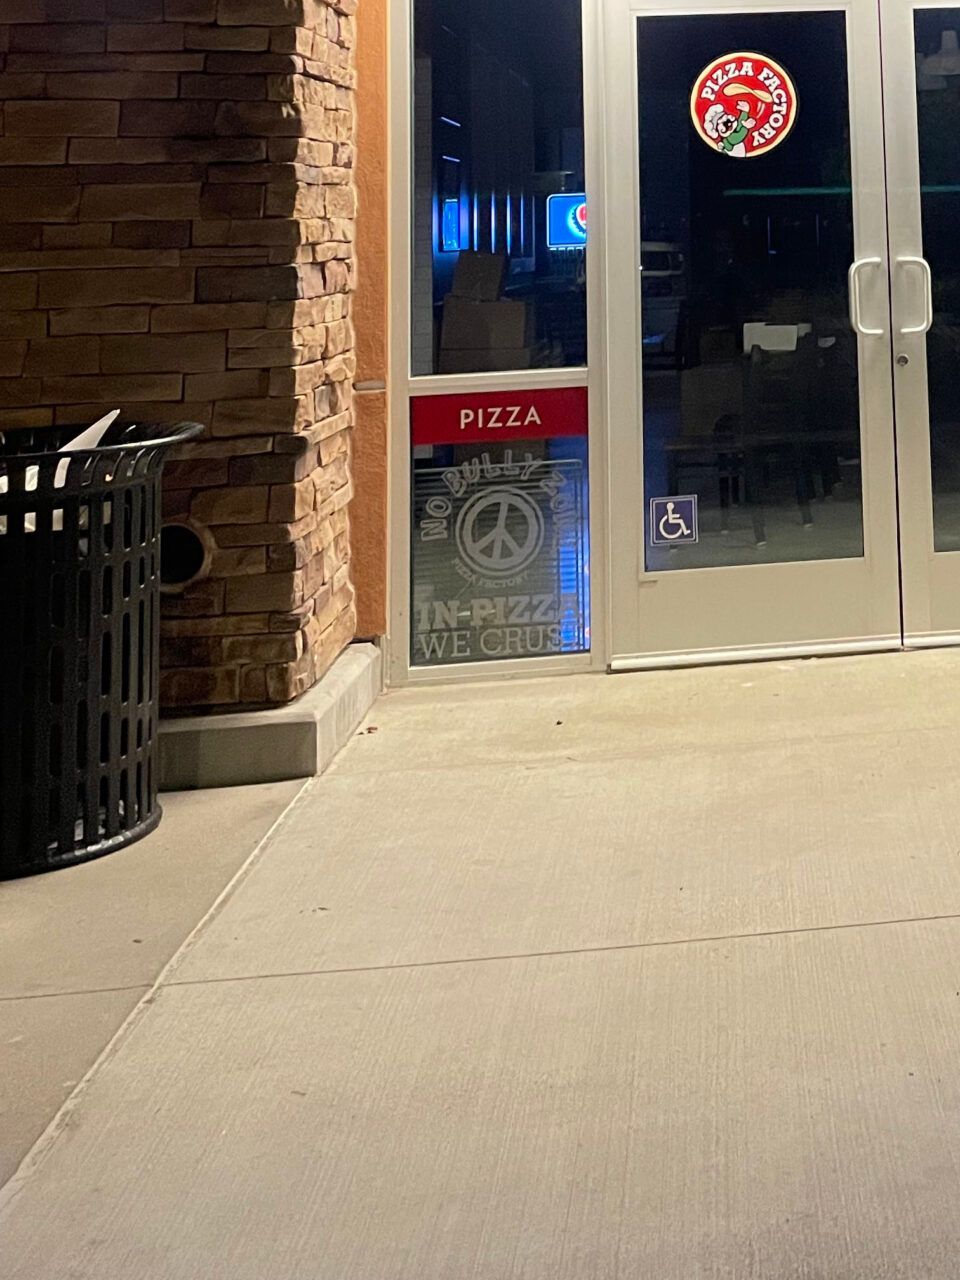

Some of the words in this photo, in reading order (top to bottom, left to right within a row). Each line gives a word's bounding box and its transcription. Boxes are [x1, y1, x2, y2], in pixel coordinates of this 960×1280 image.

[700, 61, 754, 102] PIZZA
[751, 67, 788, 147] FACTORY
[460, 406, 542, 430] PIZZA
[420, 496, 451, 542] NO
[441, 449, 542, 498] BULLY
[418, 600, 460, 632] IN
[418, 631, 471, 660] WE
[480, 624, 578, 656] CRUS
